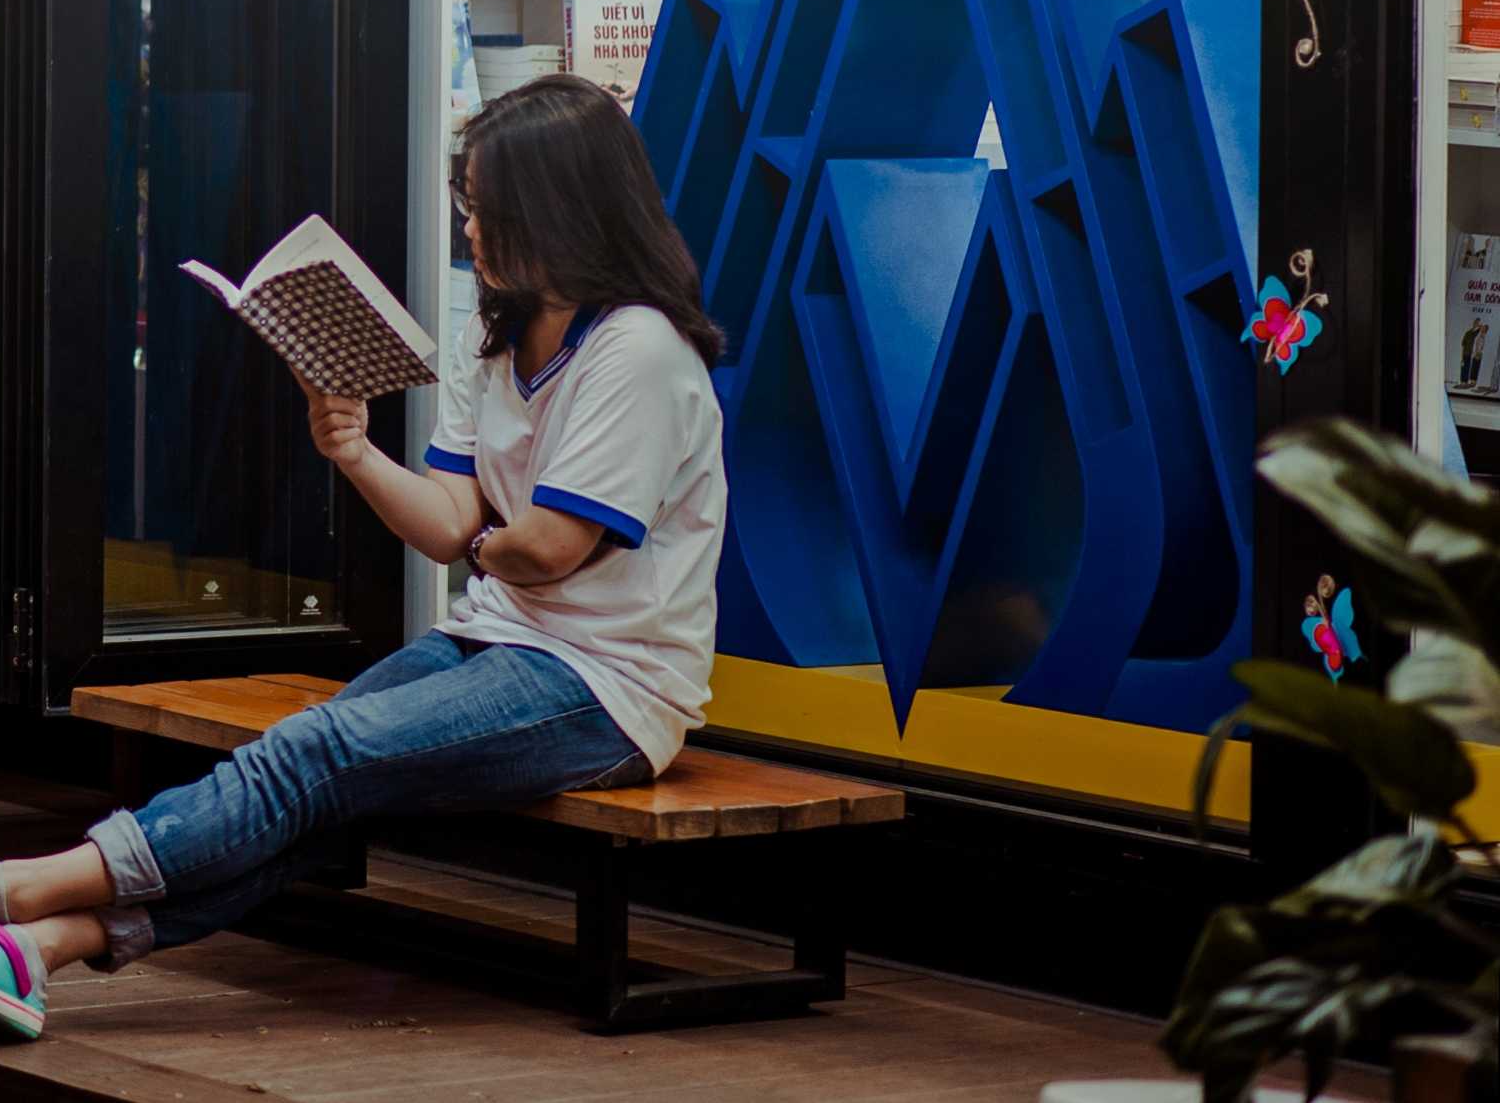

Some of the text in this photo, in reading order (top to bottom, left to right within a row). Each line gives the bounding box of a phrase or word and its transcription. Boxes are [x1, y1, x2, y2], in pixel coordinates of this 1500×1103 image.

[602, 2, 644, 20] VIẾT VÌ
[622, 41, 649, 59] NÔN
